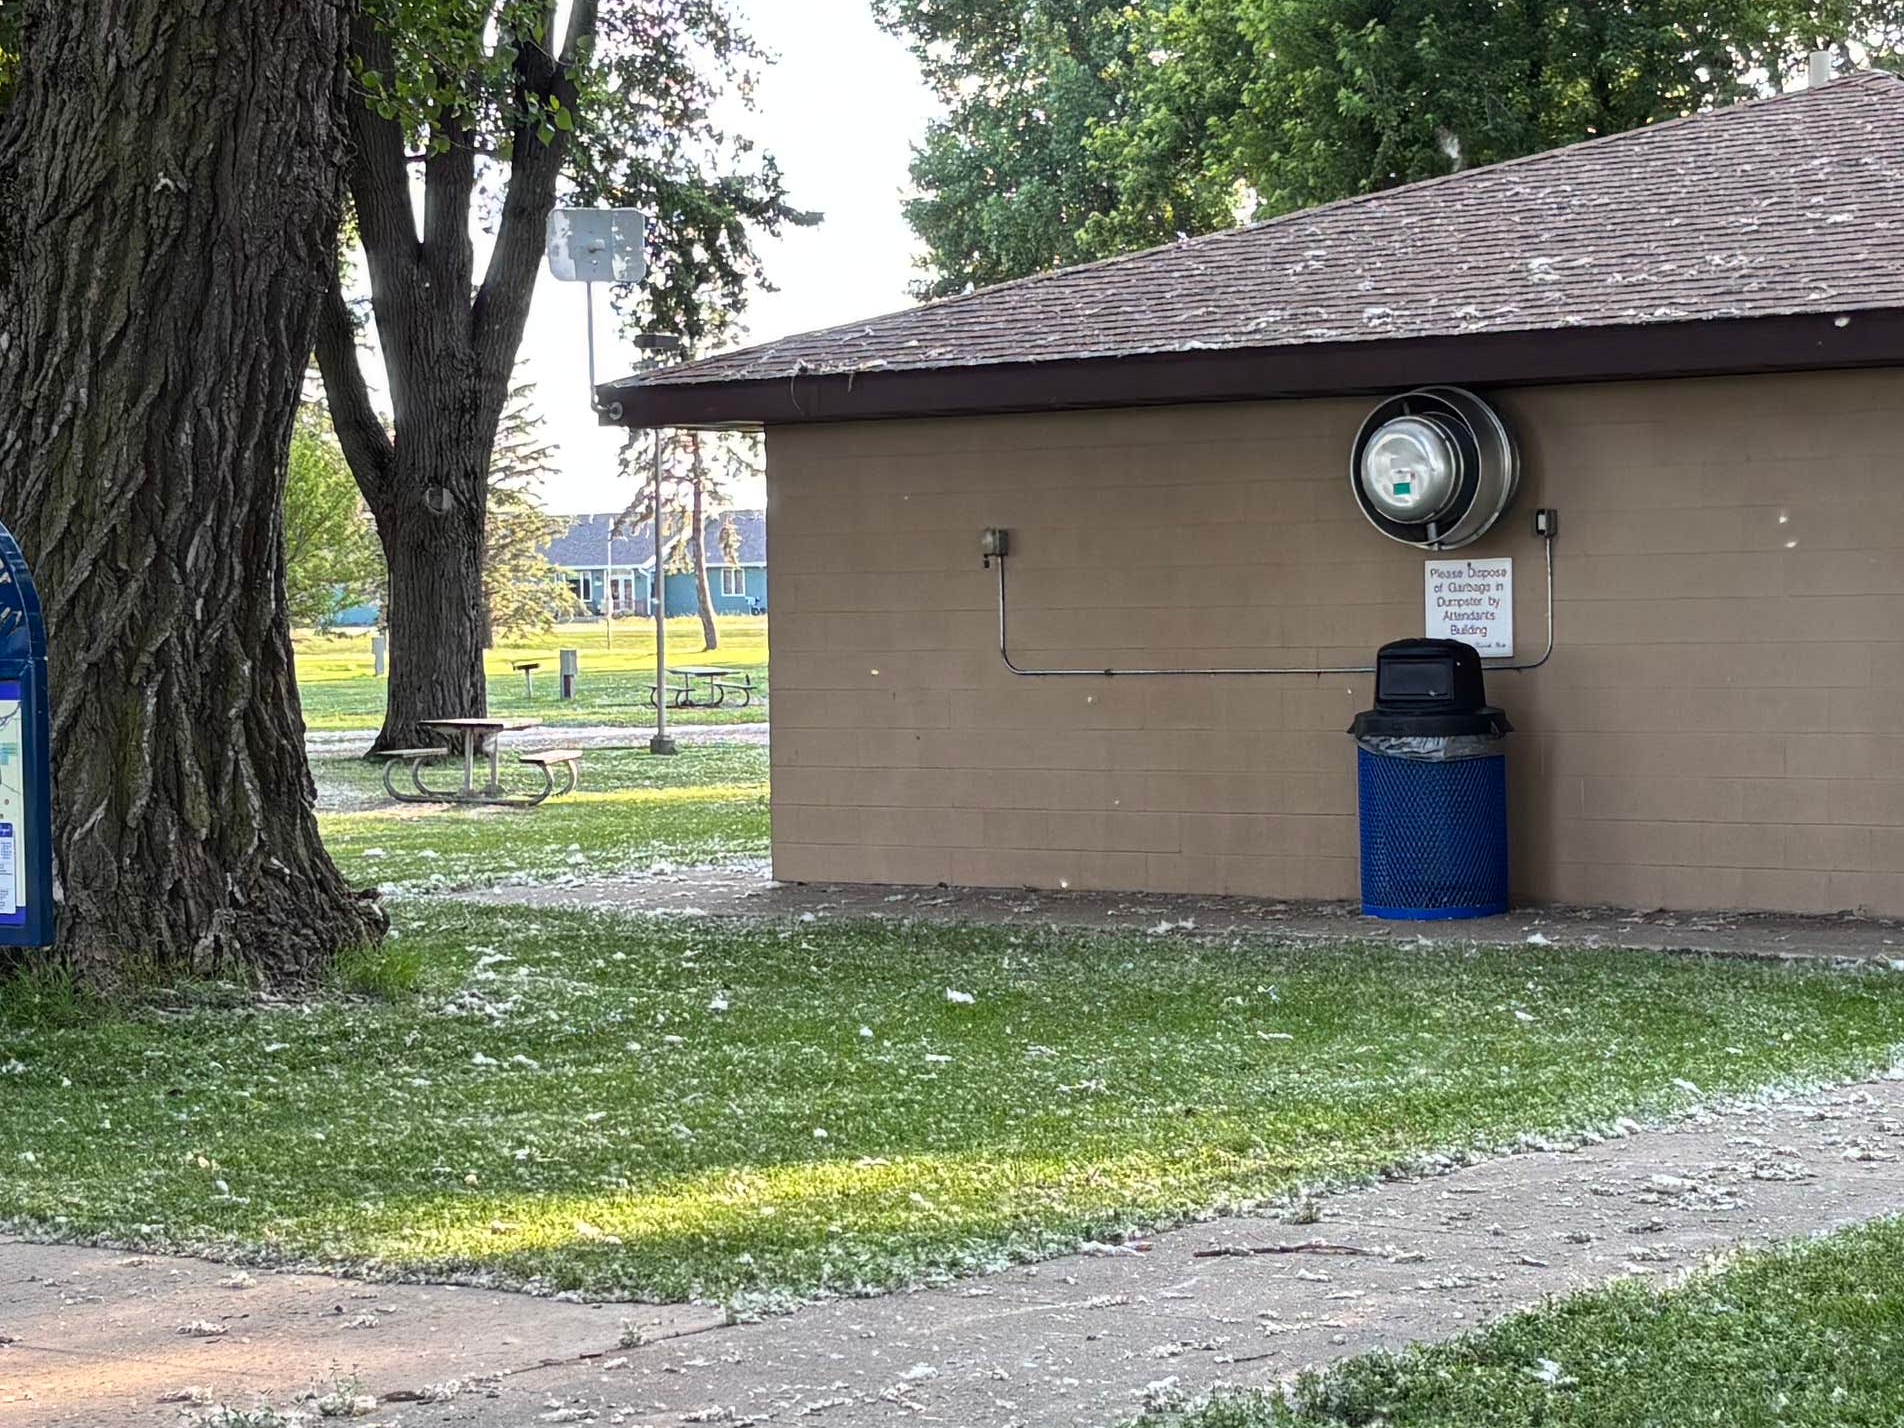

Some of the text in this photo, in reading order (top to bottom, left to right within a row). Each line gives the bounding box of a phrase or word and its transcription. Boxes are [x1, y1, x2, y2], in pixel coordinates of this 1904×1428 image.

[1430, 568, 1464, 579] Please
[1434, 582, 1504, 594] of Garbage in
[1436, 596, 1500, 609] Dumpster by
[1443, 610, 1496, 621] Attendants
[1450, 624, 1488, 637] Building
